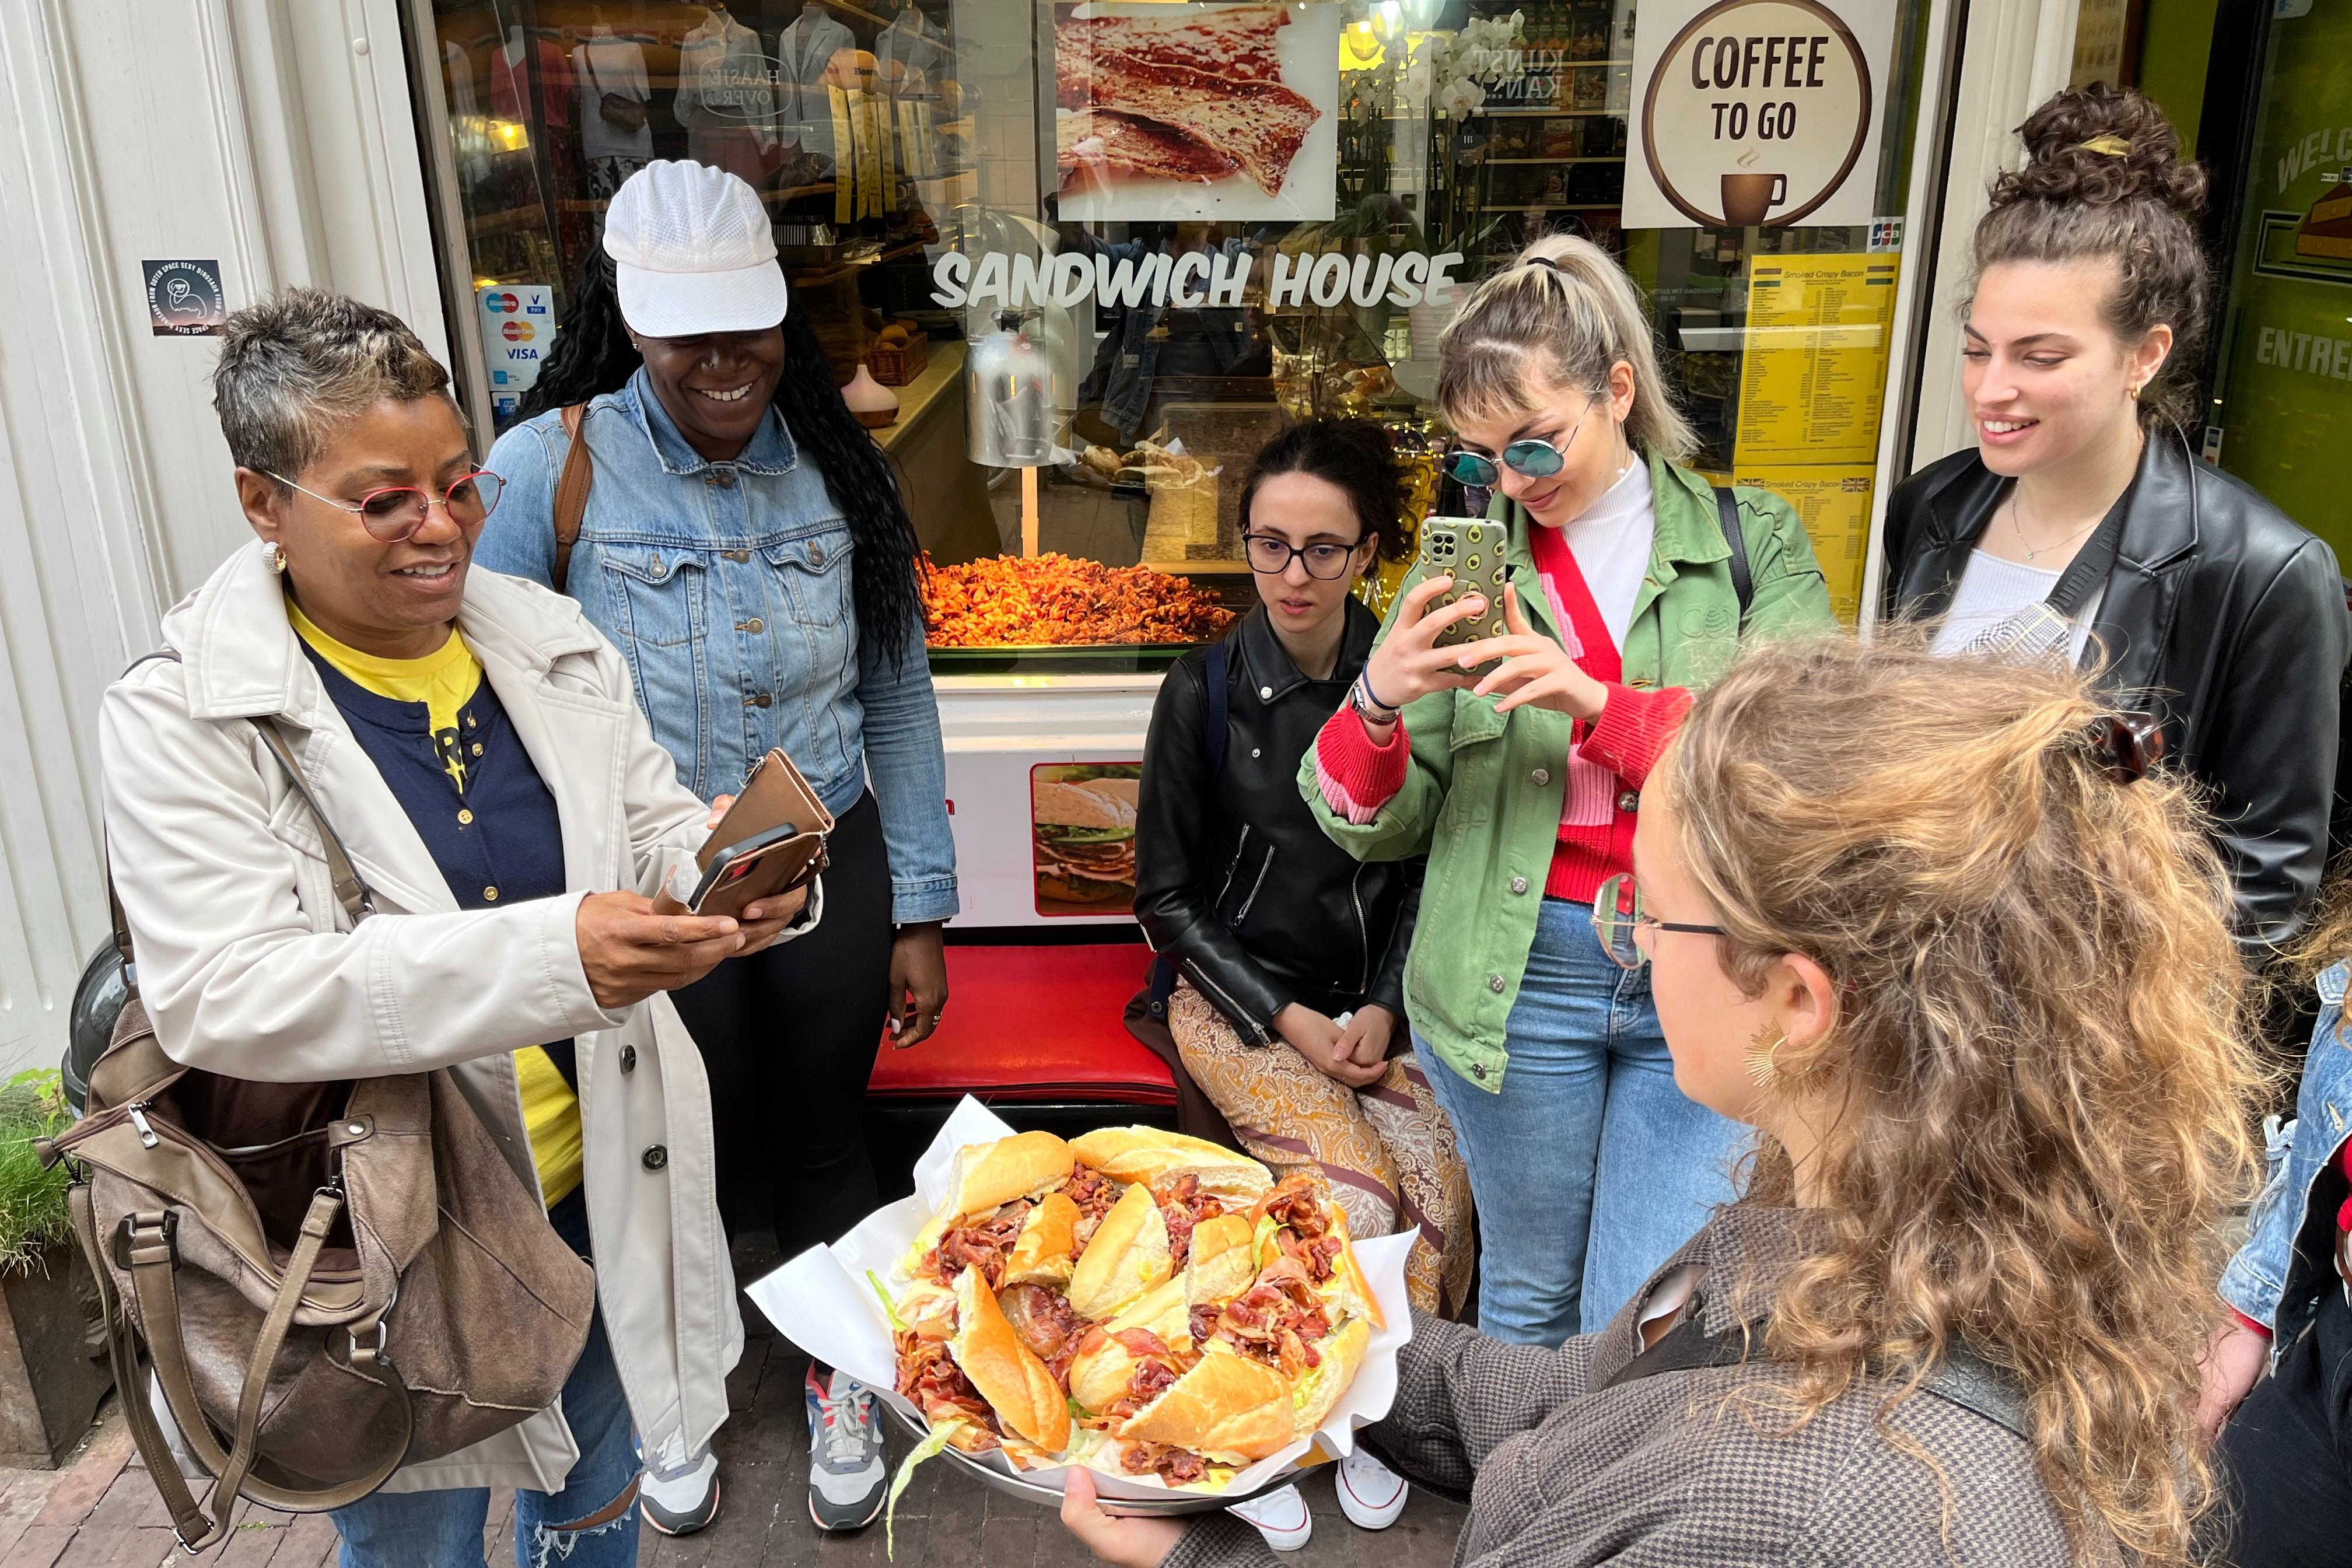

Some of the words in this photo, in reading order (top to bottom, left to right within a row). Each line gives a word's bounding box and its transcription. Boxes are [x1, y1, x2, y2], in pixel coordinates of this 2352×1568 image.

[1692, 36, 1829, 90] COFFEE
[1711, 102, 1748, 141] TO
[1757, 102, 1796, 140] GO
[1871, 230, 1900, 239] JCB
[161, 262, 180, 273] SPACE
[181, 262, 196, 271] SEXY
[150, 270, 163, 286] OUTER
[930, 251, 1253, 309] SANDWICH
[1269, 251, 1464, 308] HOUSE
[1816, 271, 1839, 279] Crispy
[531, 295, 540, 305] V
[175, 326, 190, 334] SEXY
[506, 348, 538, 359] VISA
[2257, 326, 2352, 383] ENTRE
